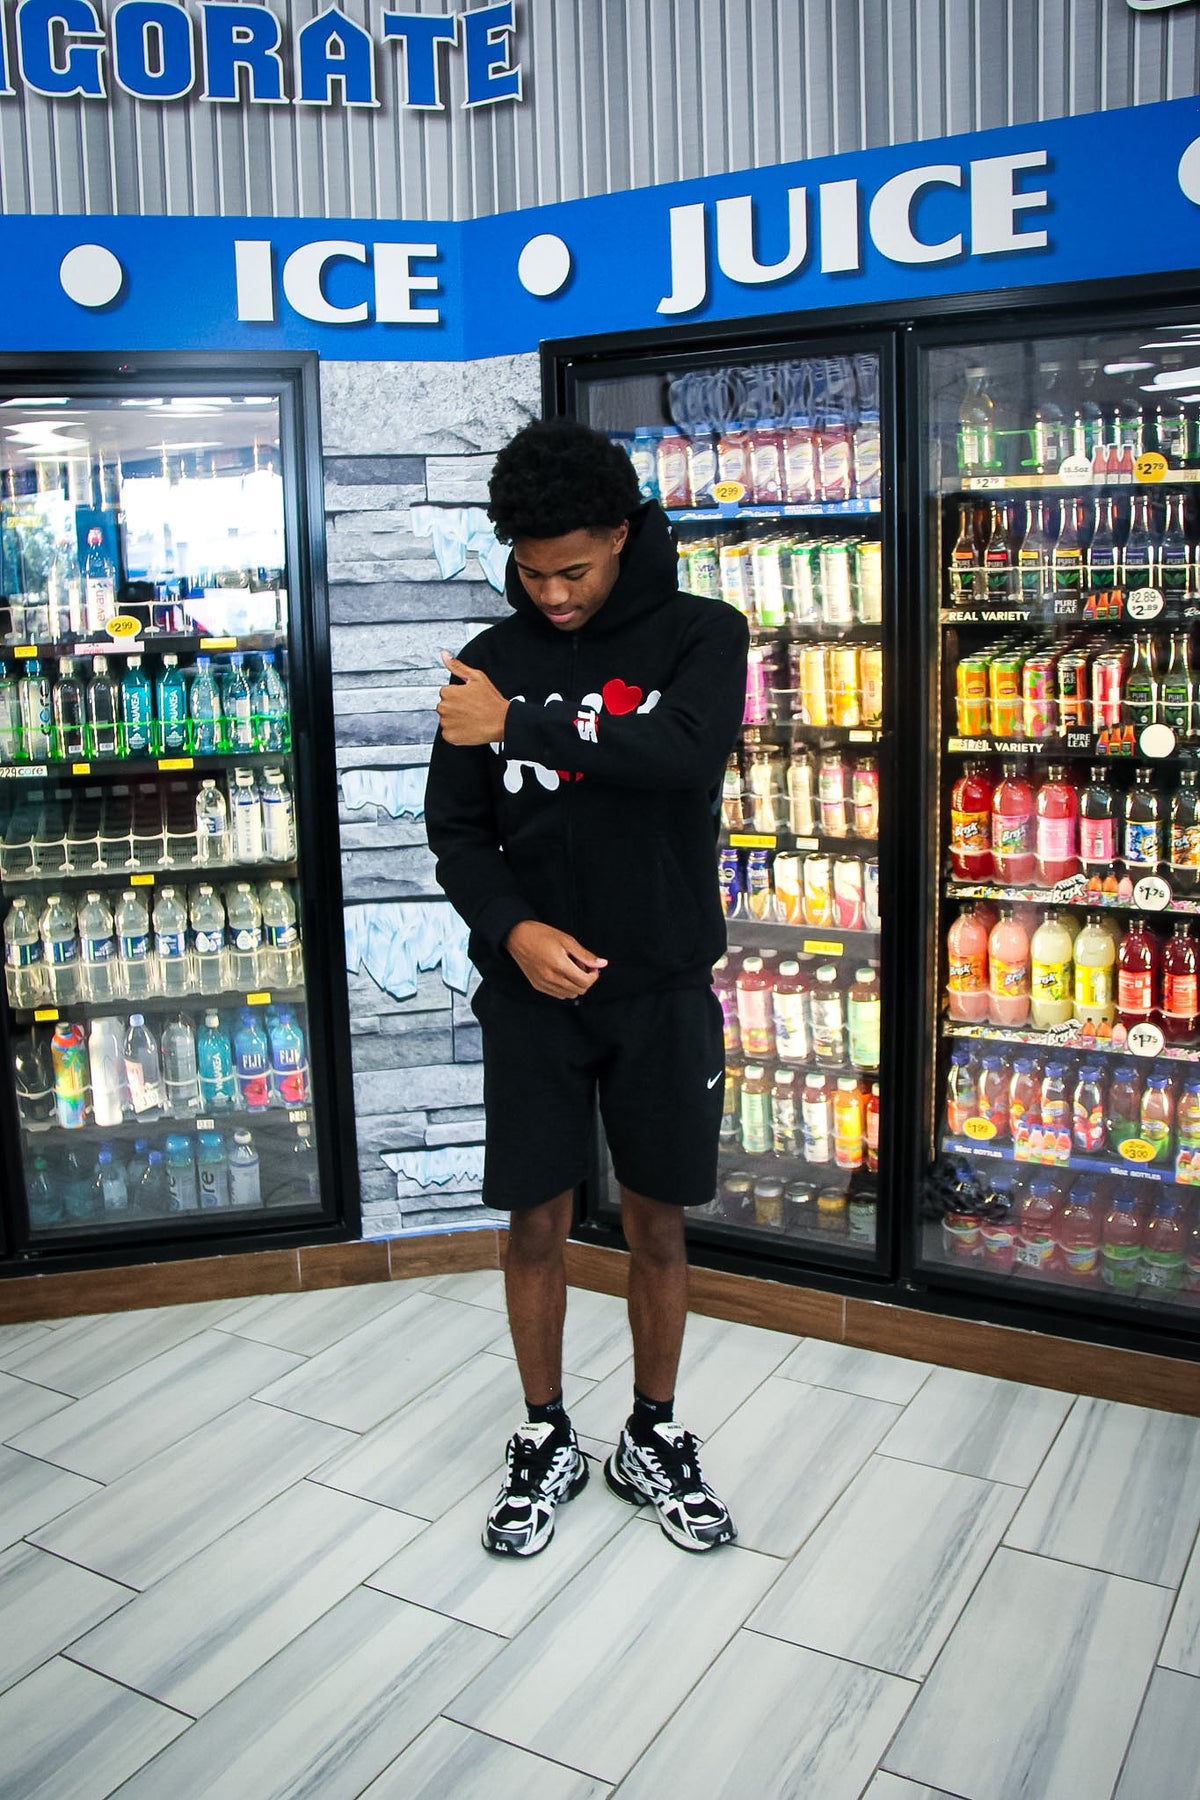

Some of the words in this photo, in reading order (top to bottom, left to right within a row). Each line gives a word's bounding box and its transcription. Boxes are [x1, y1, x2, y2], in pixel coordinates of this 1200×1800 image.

[656, 150, 1047, 314] JUICE
[234, 240, 439, 324] ICE
[948, 611, 978, 621] REAL
[981, 611, 1031, 621] VARIETY
[995, 742, 1044, 752] VARIETY
[1067, 740, 1091, 748] LEAF
[18, 766, 44, 776] core
[242, 1054, 261, 1069] FIJI
